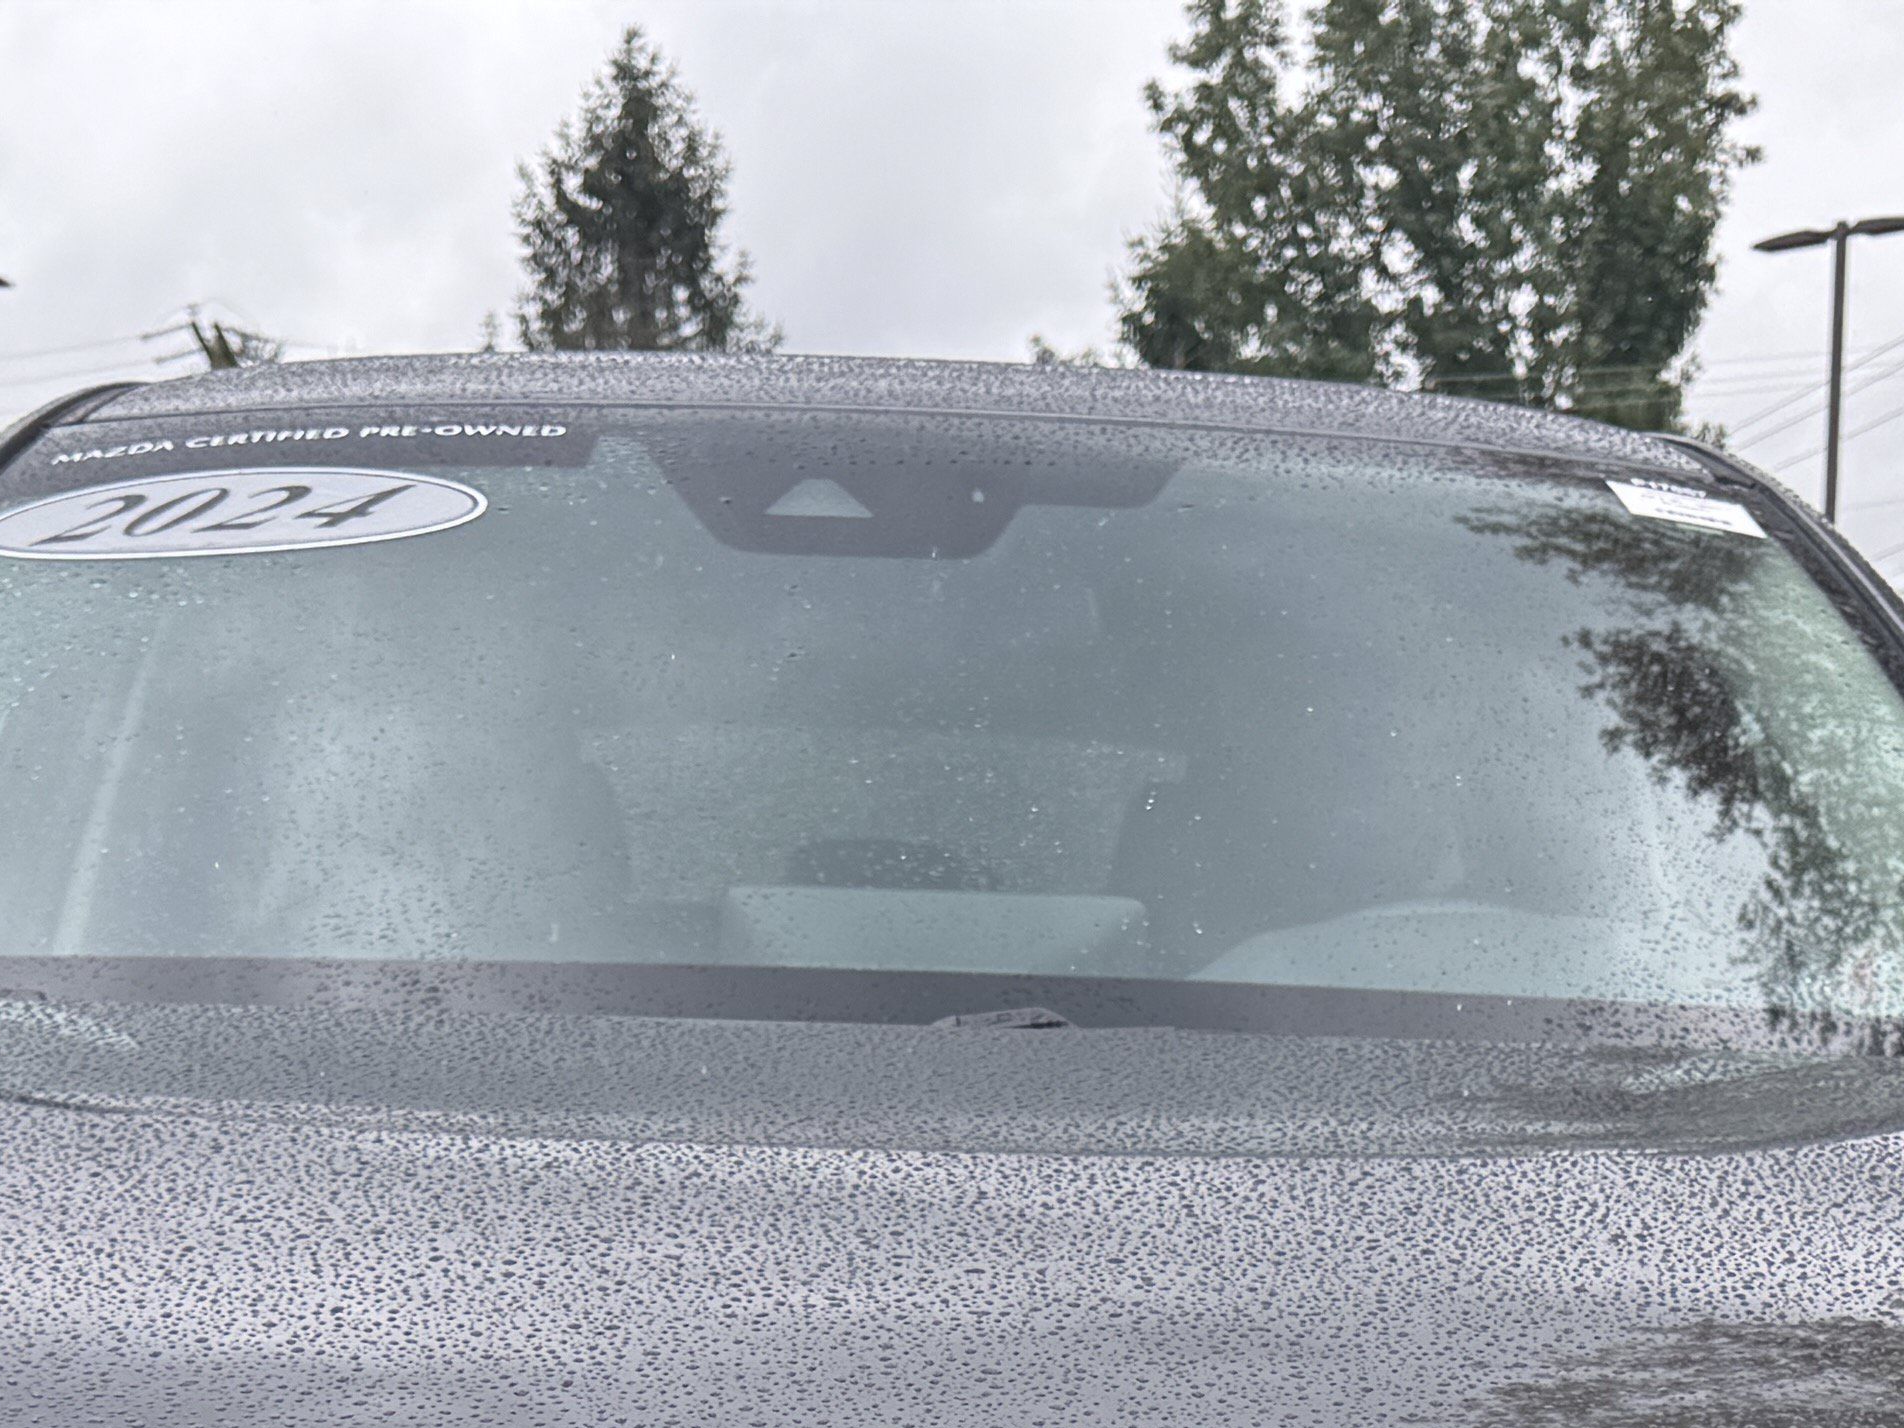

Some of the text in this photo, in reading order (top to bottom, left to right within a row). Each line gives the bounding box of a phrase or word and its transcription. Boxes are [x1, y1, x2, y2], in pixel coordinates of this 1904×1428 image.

[50, 423, 568, 466] MAZDA CERTIFIED PRE-OWNED
[28, 484, 417, 547] 2024
